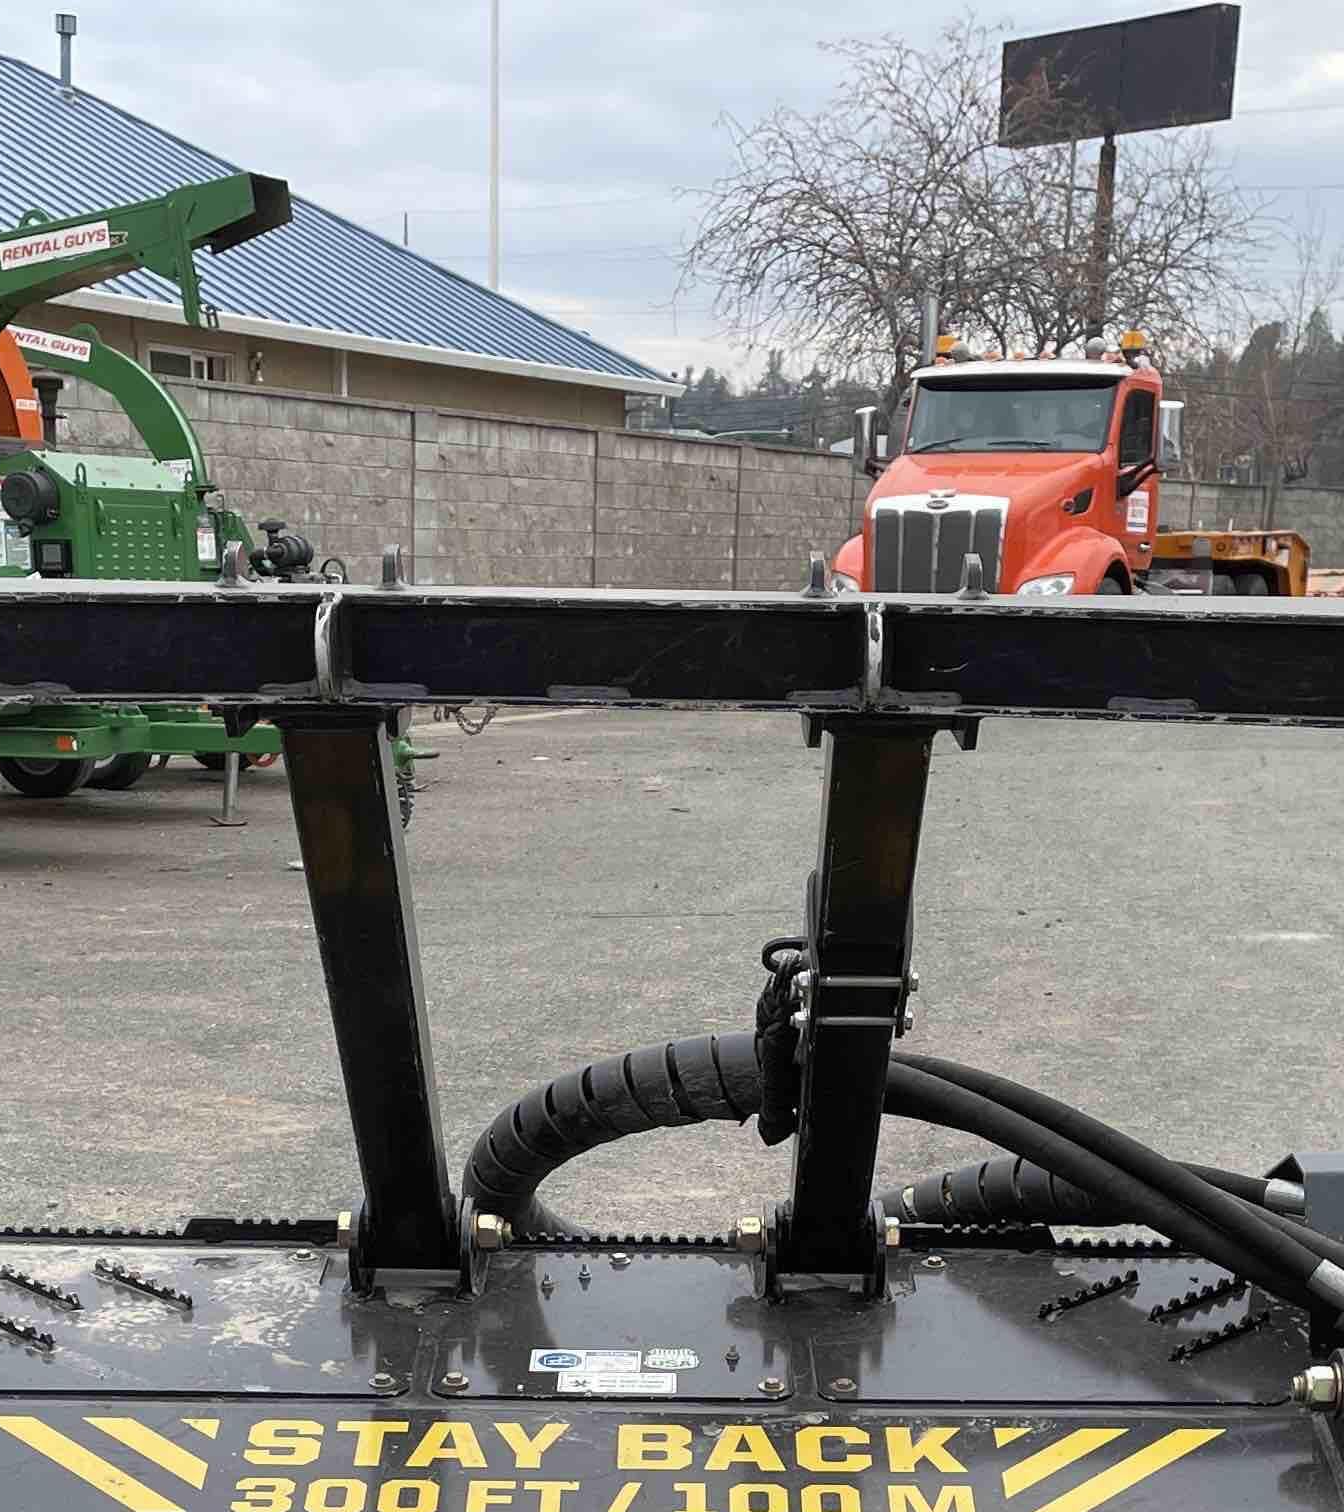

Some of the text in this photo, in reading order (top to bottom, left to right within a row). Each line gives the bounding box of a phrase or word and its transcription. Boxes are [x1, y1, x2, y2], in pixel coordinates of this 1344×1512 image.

[2, 239, 61, 262] RENTAL
[64, 229, 106, 249] GUYS
[15, 331, 88, 356] NTAL GUYS
[243, 1419, 969, 1472] STAY BACK
